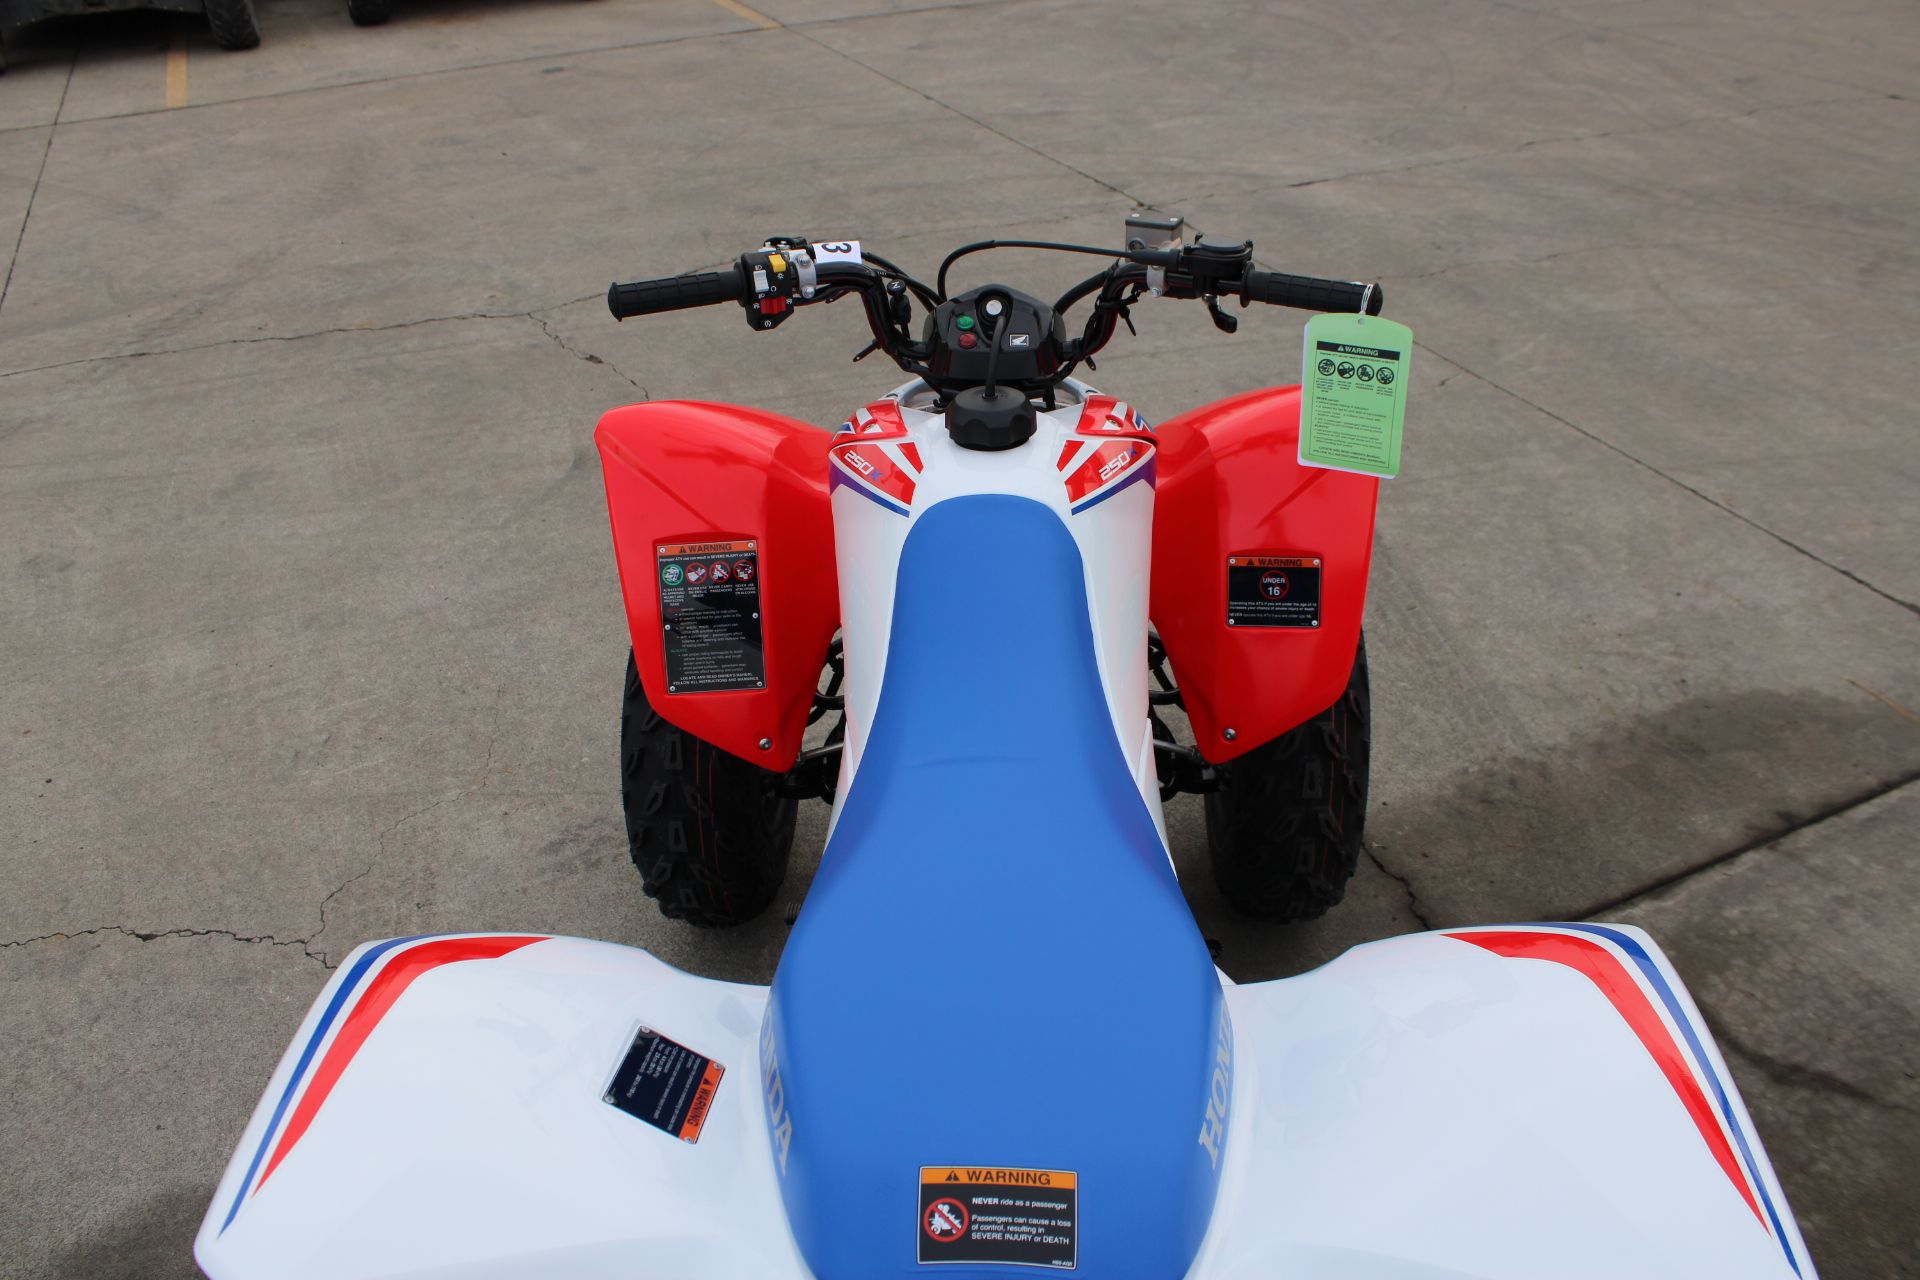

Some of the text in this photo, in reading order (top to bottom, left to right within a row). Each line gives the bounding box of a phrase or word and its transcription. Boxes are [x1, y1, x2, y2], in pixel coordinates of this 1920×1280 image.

[1345, 346, 1378, 356] WARNING
[689, 544, 732, 552] WARNING
[1268, 587, 1280, 596] 16
[1199, 999, 1234, 1171] HOND
[762, 1006, 792, 1177] ONDA
[687, 1087, 711, 1127] WARNING
[967, 1170, 1050, 1185] WARNING
[1032, 1202, 1067, 1210] passenger
[972, 1215, 1012, 1224] Passengers
[1007, 1226, 1036, 1234] resulting
[1043, 1236, 1069, 1245] DEATH
